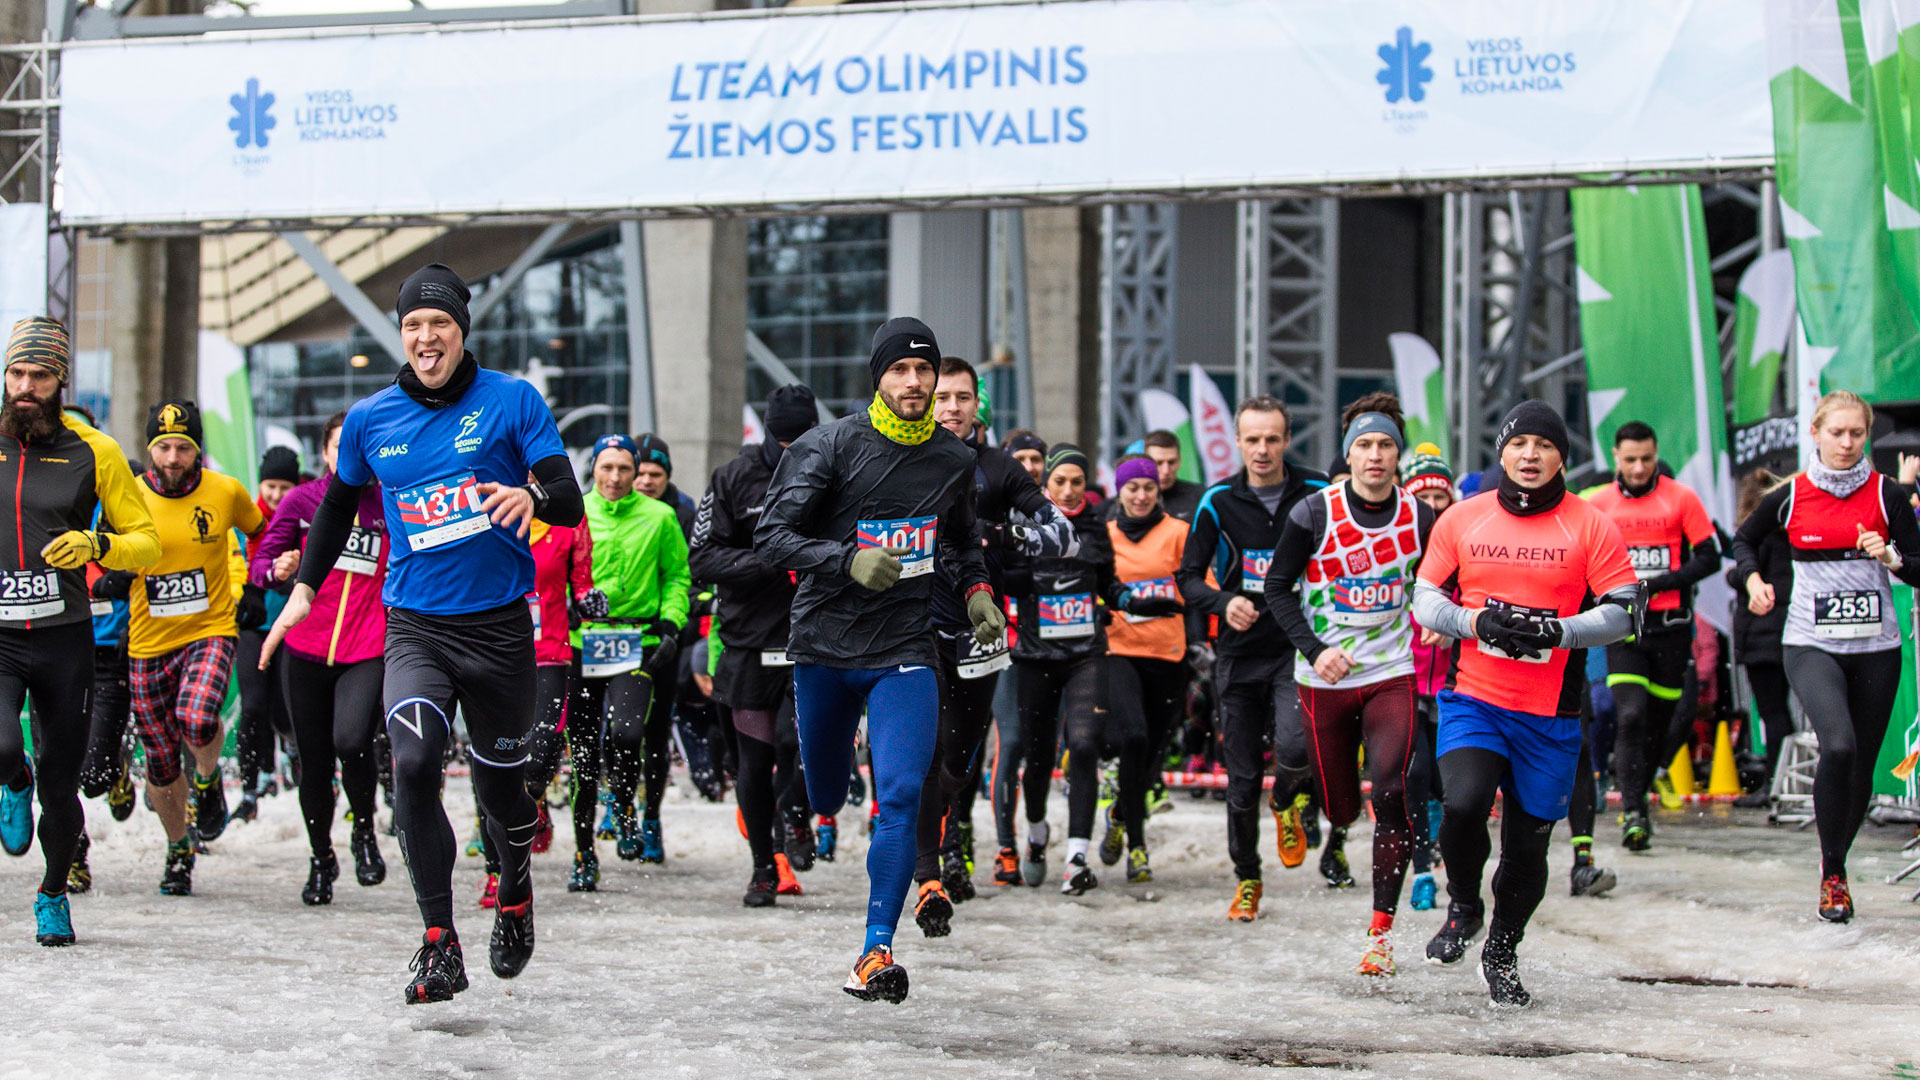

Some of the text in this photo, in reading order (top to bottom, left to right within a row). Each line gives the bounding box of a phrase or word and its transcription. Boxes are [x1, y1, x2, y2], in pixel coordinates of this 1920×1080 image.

[1466, 37, 1524, 53] VISOS
[669, 44, 1089, 102] LTEAM OLIMPINIS
[1454, 53, 1577, 78] LIETUVOS
[1461, 76, 1564, 95] KOMANDA
[305, 89, 353, 105] VISOS
[293, 104, 398, 126] LIETUVOS
[300, 125, 388, 142] KOMANDA
[667, 106, 1090, 160] ŽIEMOS FESTIVALIS
[379, 443, 409, 459] SIMAS
[1425, 477, 1449, 489] HO
[414, 486, 462, 522] 137
[345, 531, 370, 554] 61
[876, 527, 920, 552] 101
[1470, 543, 1568, 563] VIVA RENT
[2, 574, 48, 599] 258
[155, 576, 196, 600] 228
[1348, 584, 1391, 606] 090
[1052, 600, 1084, 619] 102
[1827, 595, 1869, 619] 253
[593, 639, 630, 659] 219
